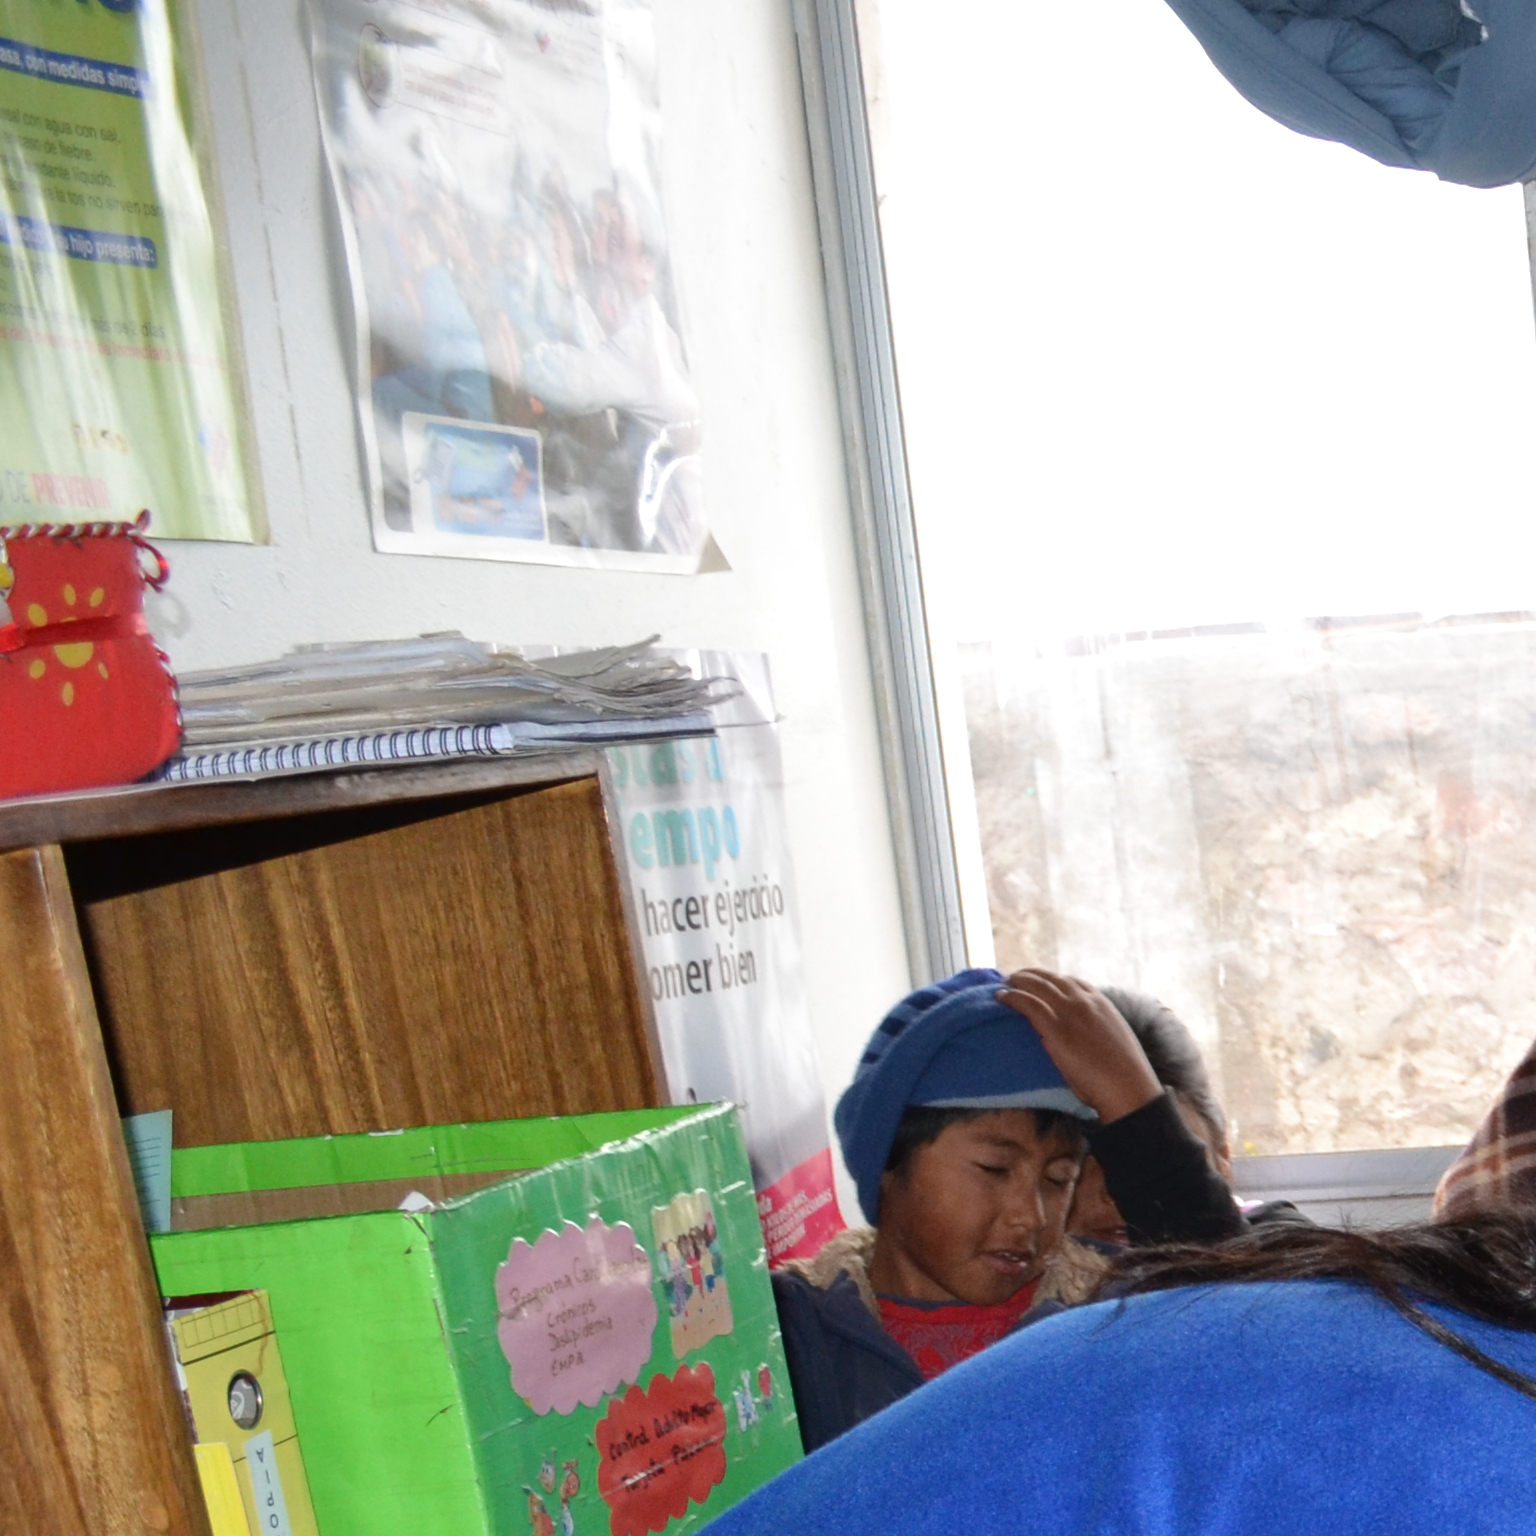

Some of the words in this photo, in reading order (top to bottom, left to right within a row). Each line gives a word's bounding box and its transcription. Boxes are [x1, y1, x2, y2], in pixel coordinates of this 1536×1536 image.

[25, 54, 45, 74] con
[48, 60, 107, 86] medidas
[45, 116, 73, 137] agua
[75, 121, 97, 138] con
[70, 234, 94, 258] hijo
[95, 239, 156, 263] presenta:
[5, 469, 32, 504] DE
[641, 887, 711, 938] hacer
[715, 873, 786, 939] ejercicio
[716, 942, 758, 991] bien
[509, 1273, 573, 1312] Programa
